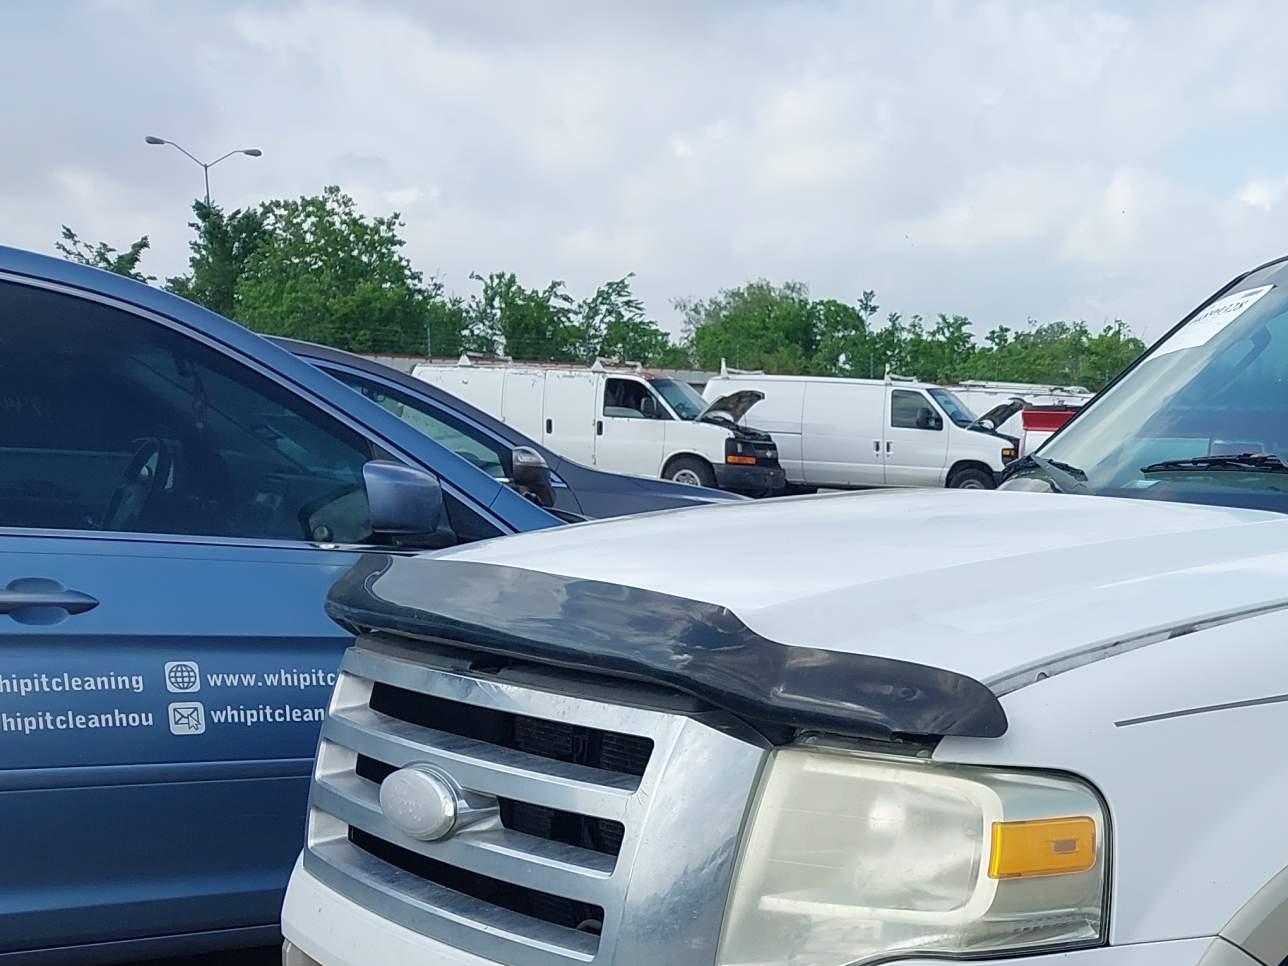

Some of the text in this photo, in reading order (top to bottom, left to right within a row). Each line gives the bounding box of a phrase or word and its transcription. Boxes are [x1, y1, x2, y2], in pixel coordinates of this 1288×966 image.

[207, 668, 340, 690] www.whipitc
[1, 708, 154, 734] hipitcleanhou
[210, 704, 325, 726] whipitclean
